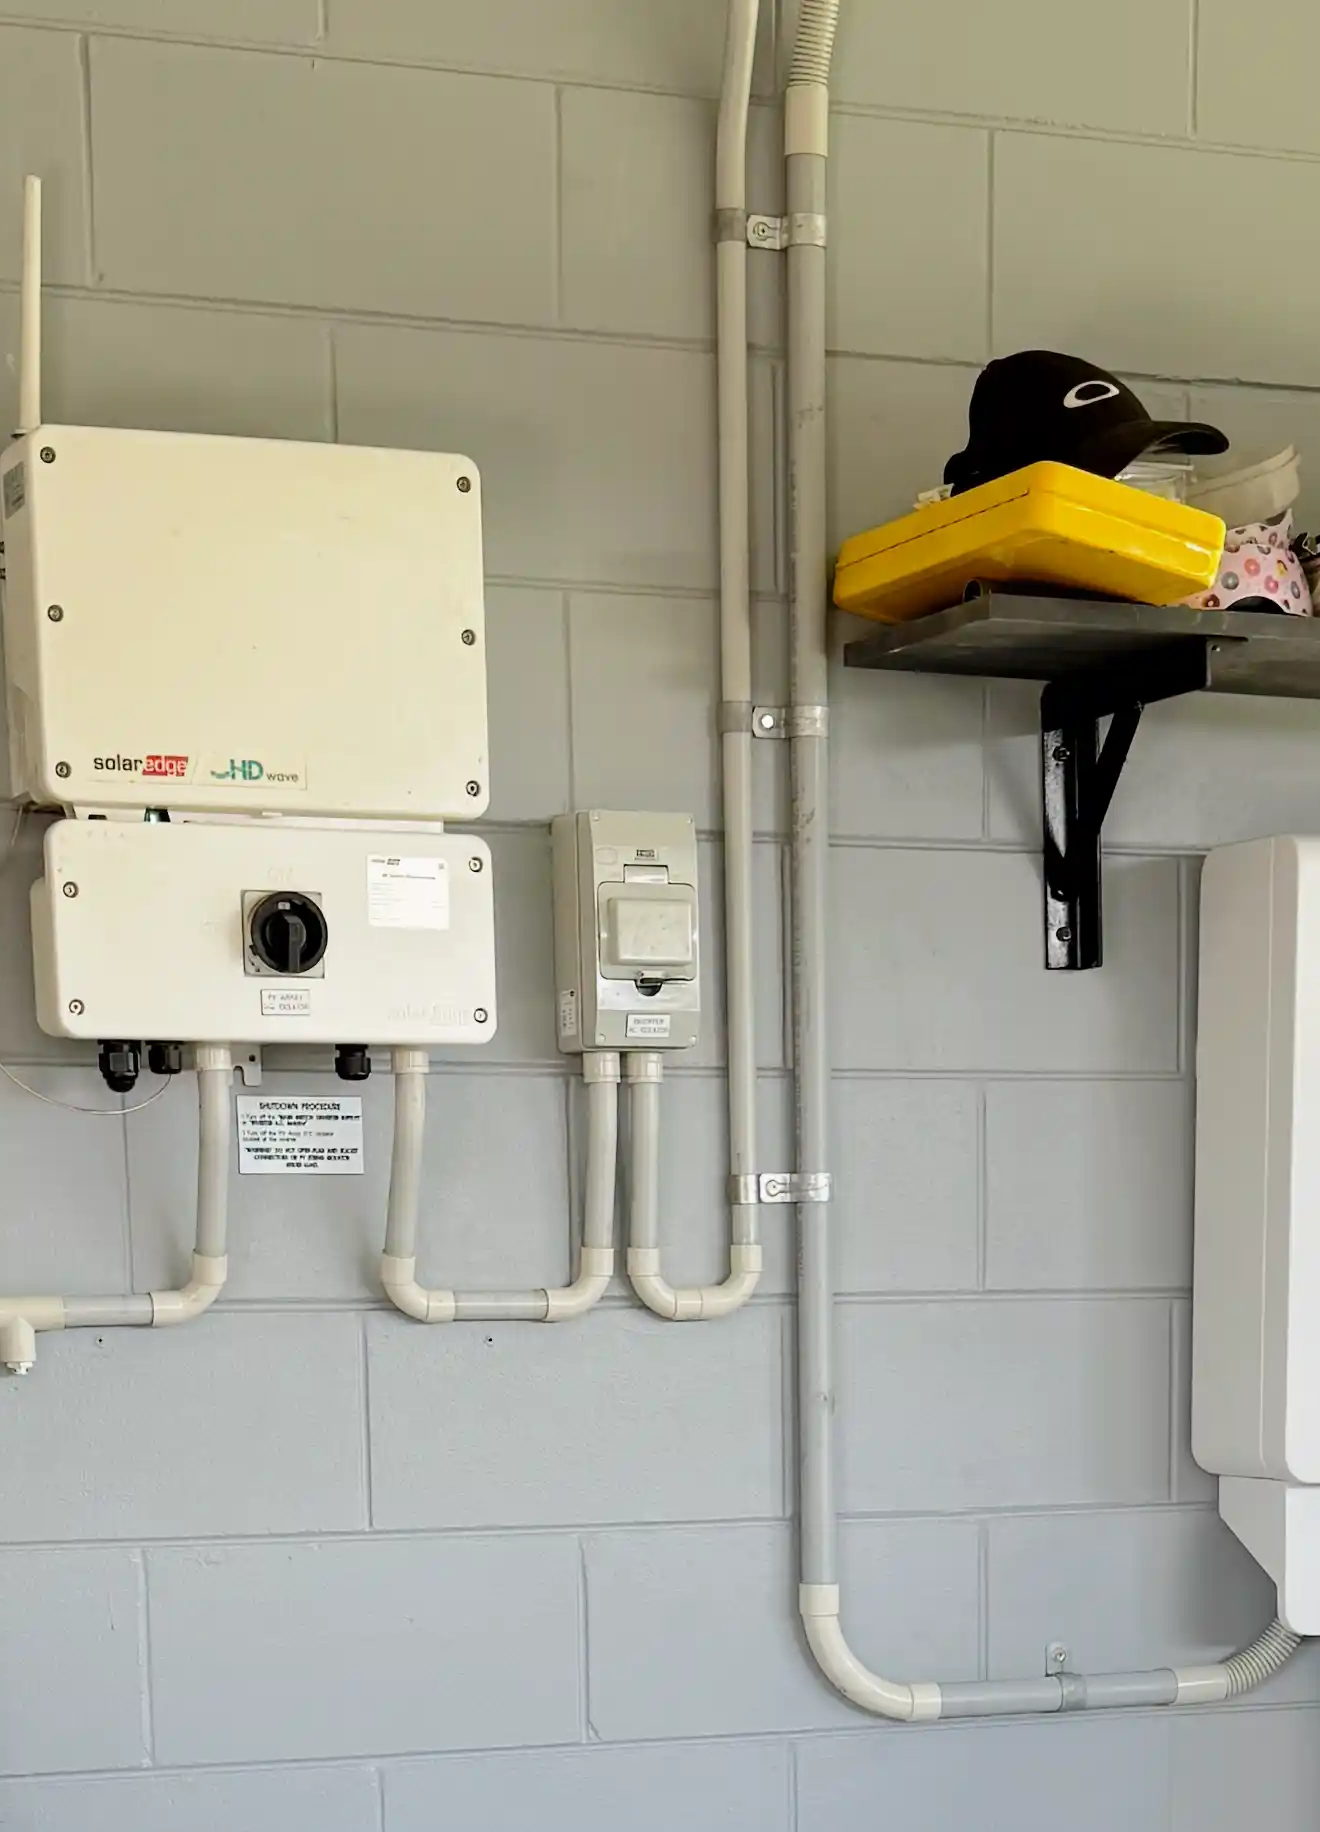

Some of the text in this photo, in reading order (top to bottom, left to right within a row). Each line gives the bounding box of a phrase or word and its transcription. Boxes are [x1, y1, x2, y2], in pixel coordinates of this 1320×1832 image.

[93, 754, 189, 777] solaredge
[229, 759, 299, 783] HD wave
